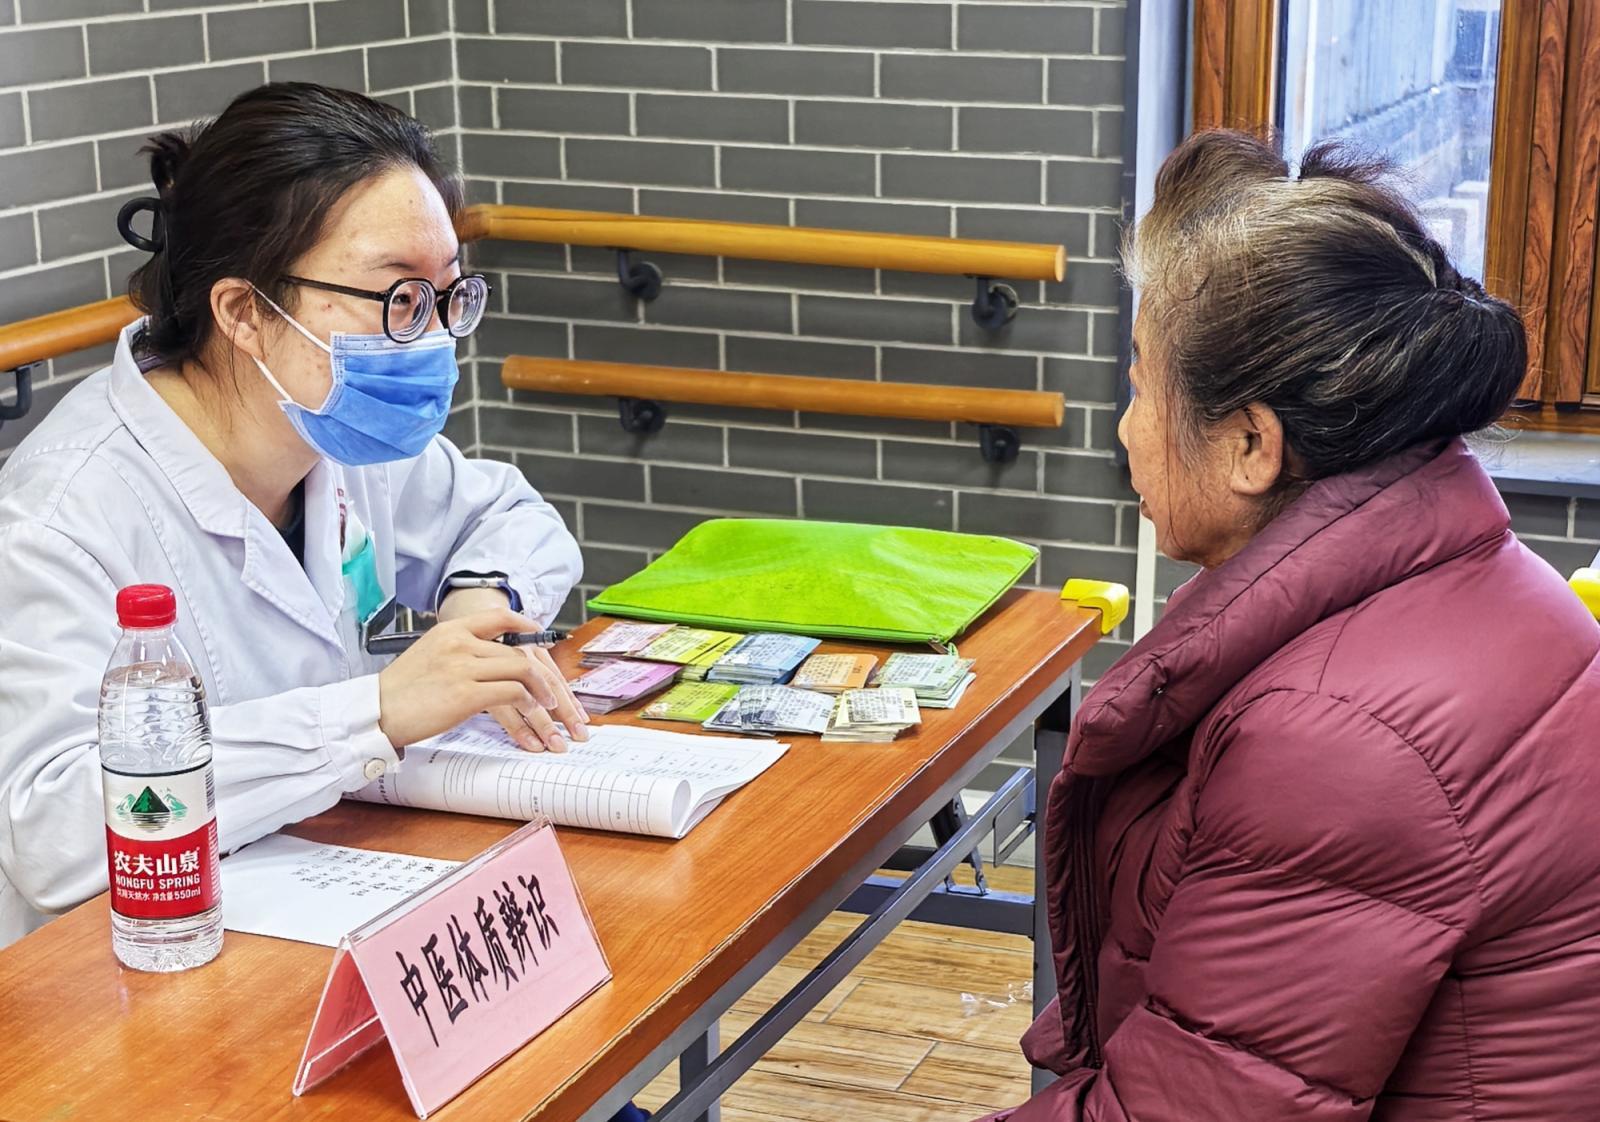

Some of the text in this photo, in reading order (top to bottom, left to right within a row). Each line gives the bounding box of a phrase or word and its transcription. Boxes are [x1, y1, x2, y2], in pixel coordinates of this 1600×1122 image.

[114, 850, 200, 876] 农夫山泉
[115, 873, 200, 890] NONGFU SPRING
[396, 874, 560, 1047] 中医体质辨识
